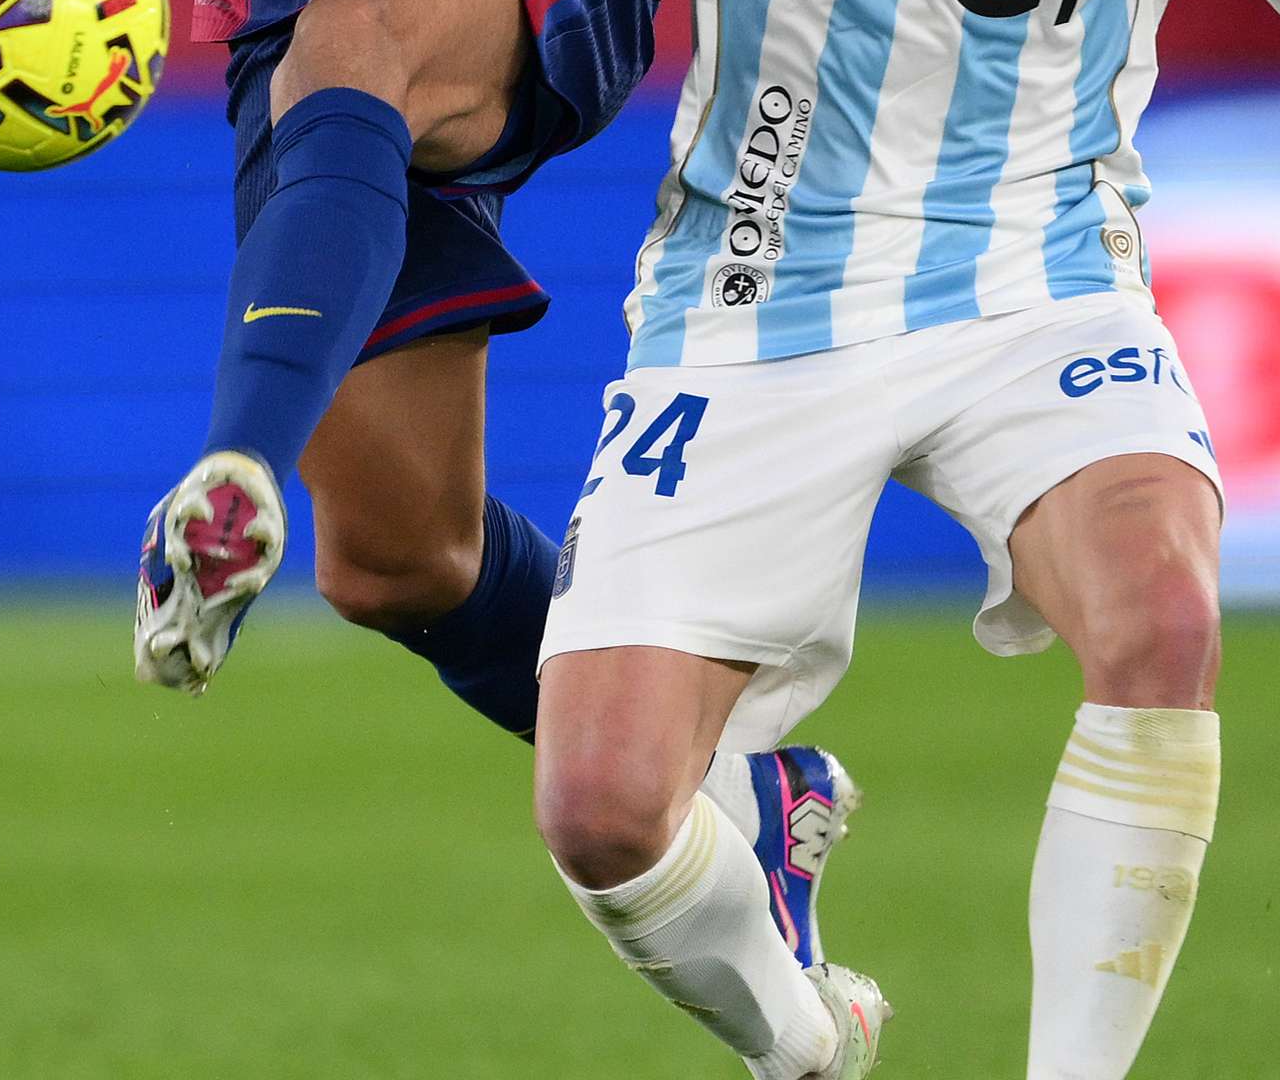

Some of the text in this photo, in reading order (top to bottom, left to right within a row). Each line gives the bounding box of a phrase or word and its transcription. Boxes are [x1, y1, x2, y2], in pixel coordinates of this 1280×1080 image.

[728, 85, 793, 257] OVIEDO
[782, 98, 812, 178] CAMINO
[581, 392, 710, 498] 24
